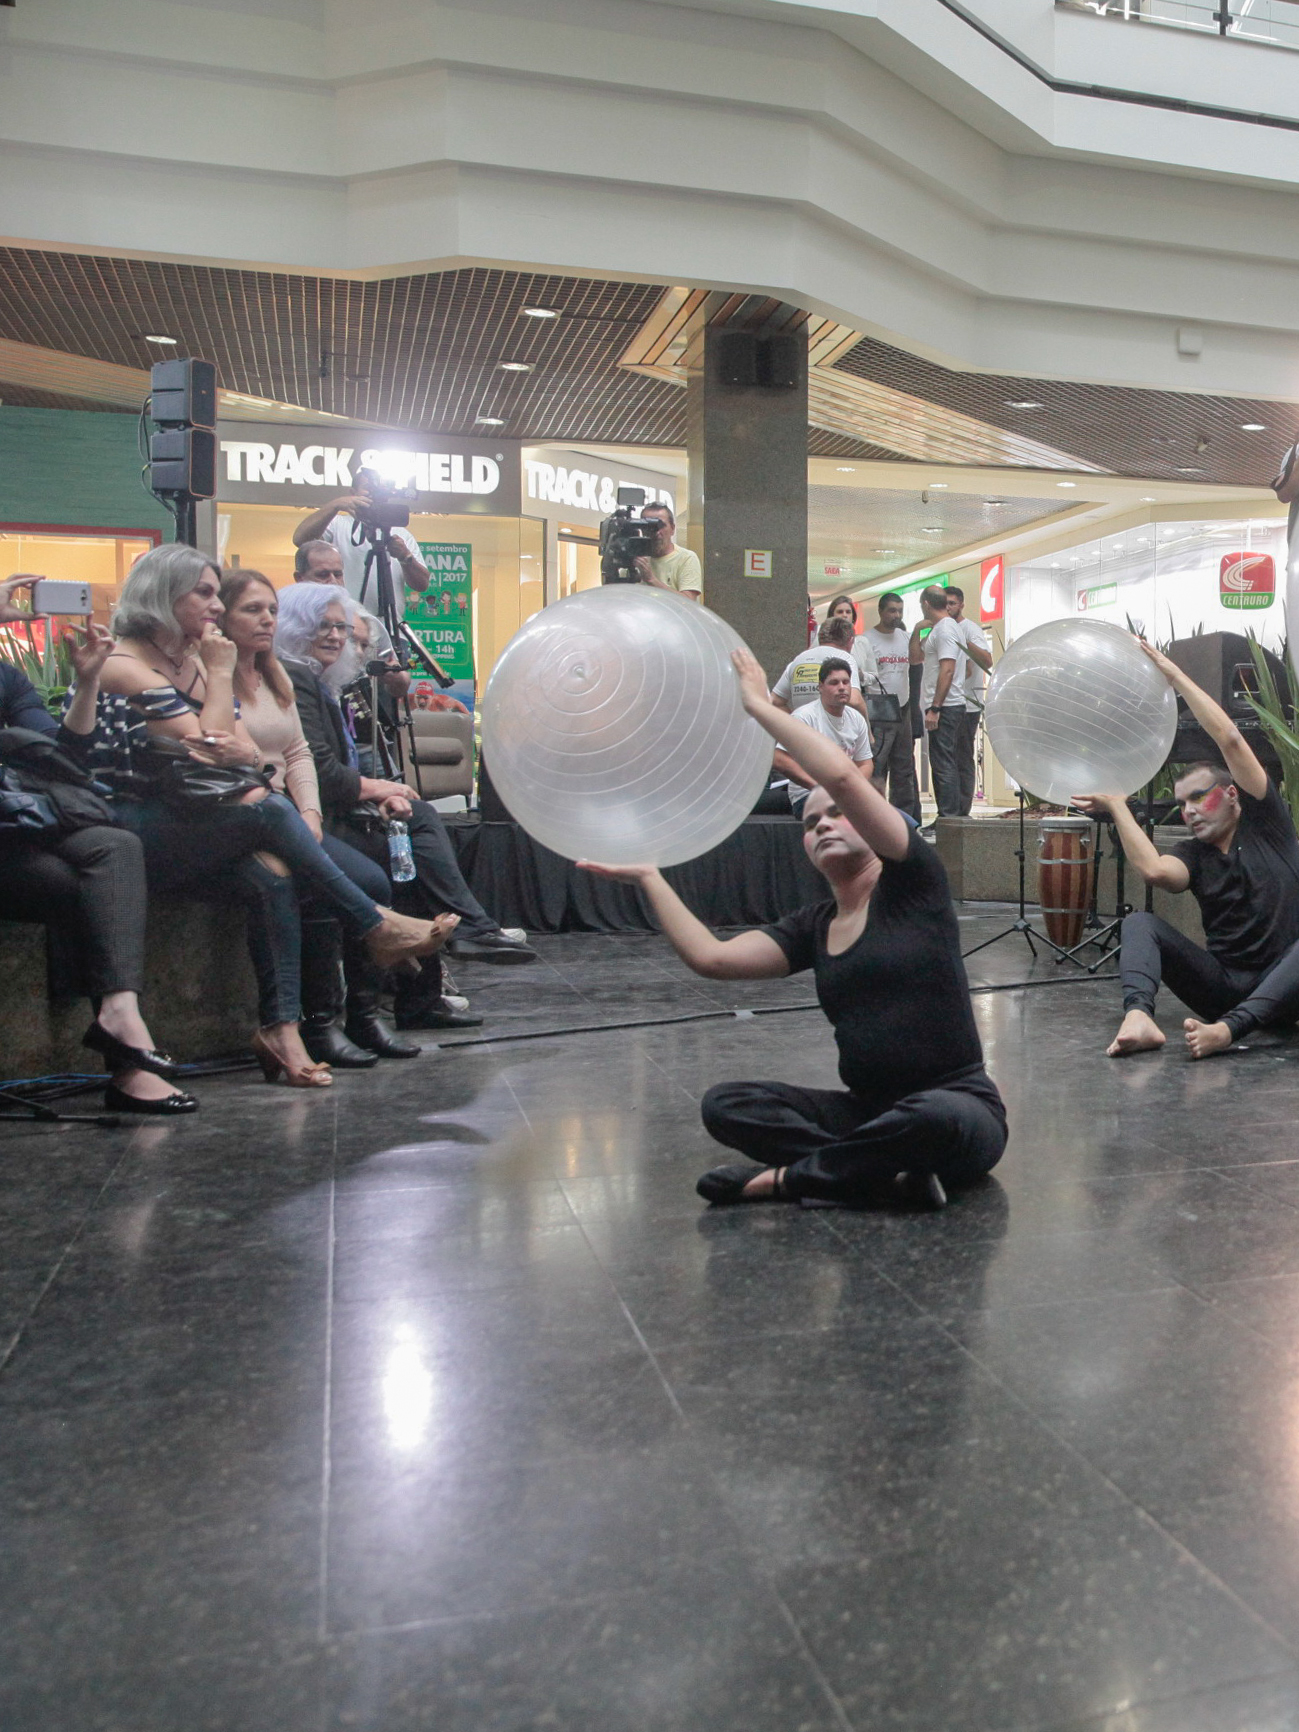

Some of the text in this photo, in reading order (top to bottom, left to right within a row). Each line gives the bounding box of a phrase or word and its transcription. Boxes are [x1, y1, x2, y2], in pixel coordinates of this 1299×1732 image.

[220, 441, 354, 487] TRACK
[524, 459, 600, 511] TRACK
[600, 476, 616, 514] &
[425, 554, 467, 570] ANA
[751, 553, 765, 571] E
[443, 573, 467, 582] 2017
[1222, 594, 1269, 606] CENTAURO
[414, 629, 466, 643] RTURA
[436, 644, 454, 653] 14h
